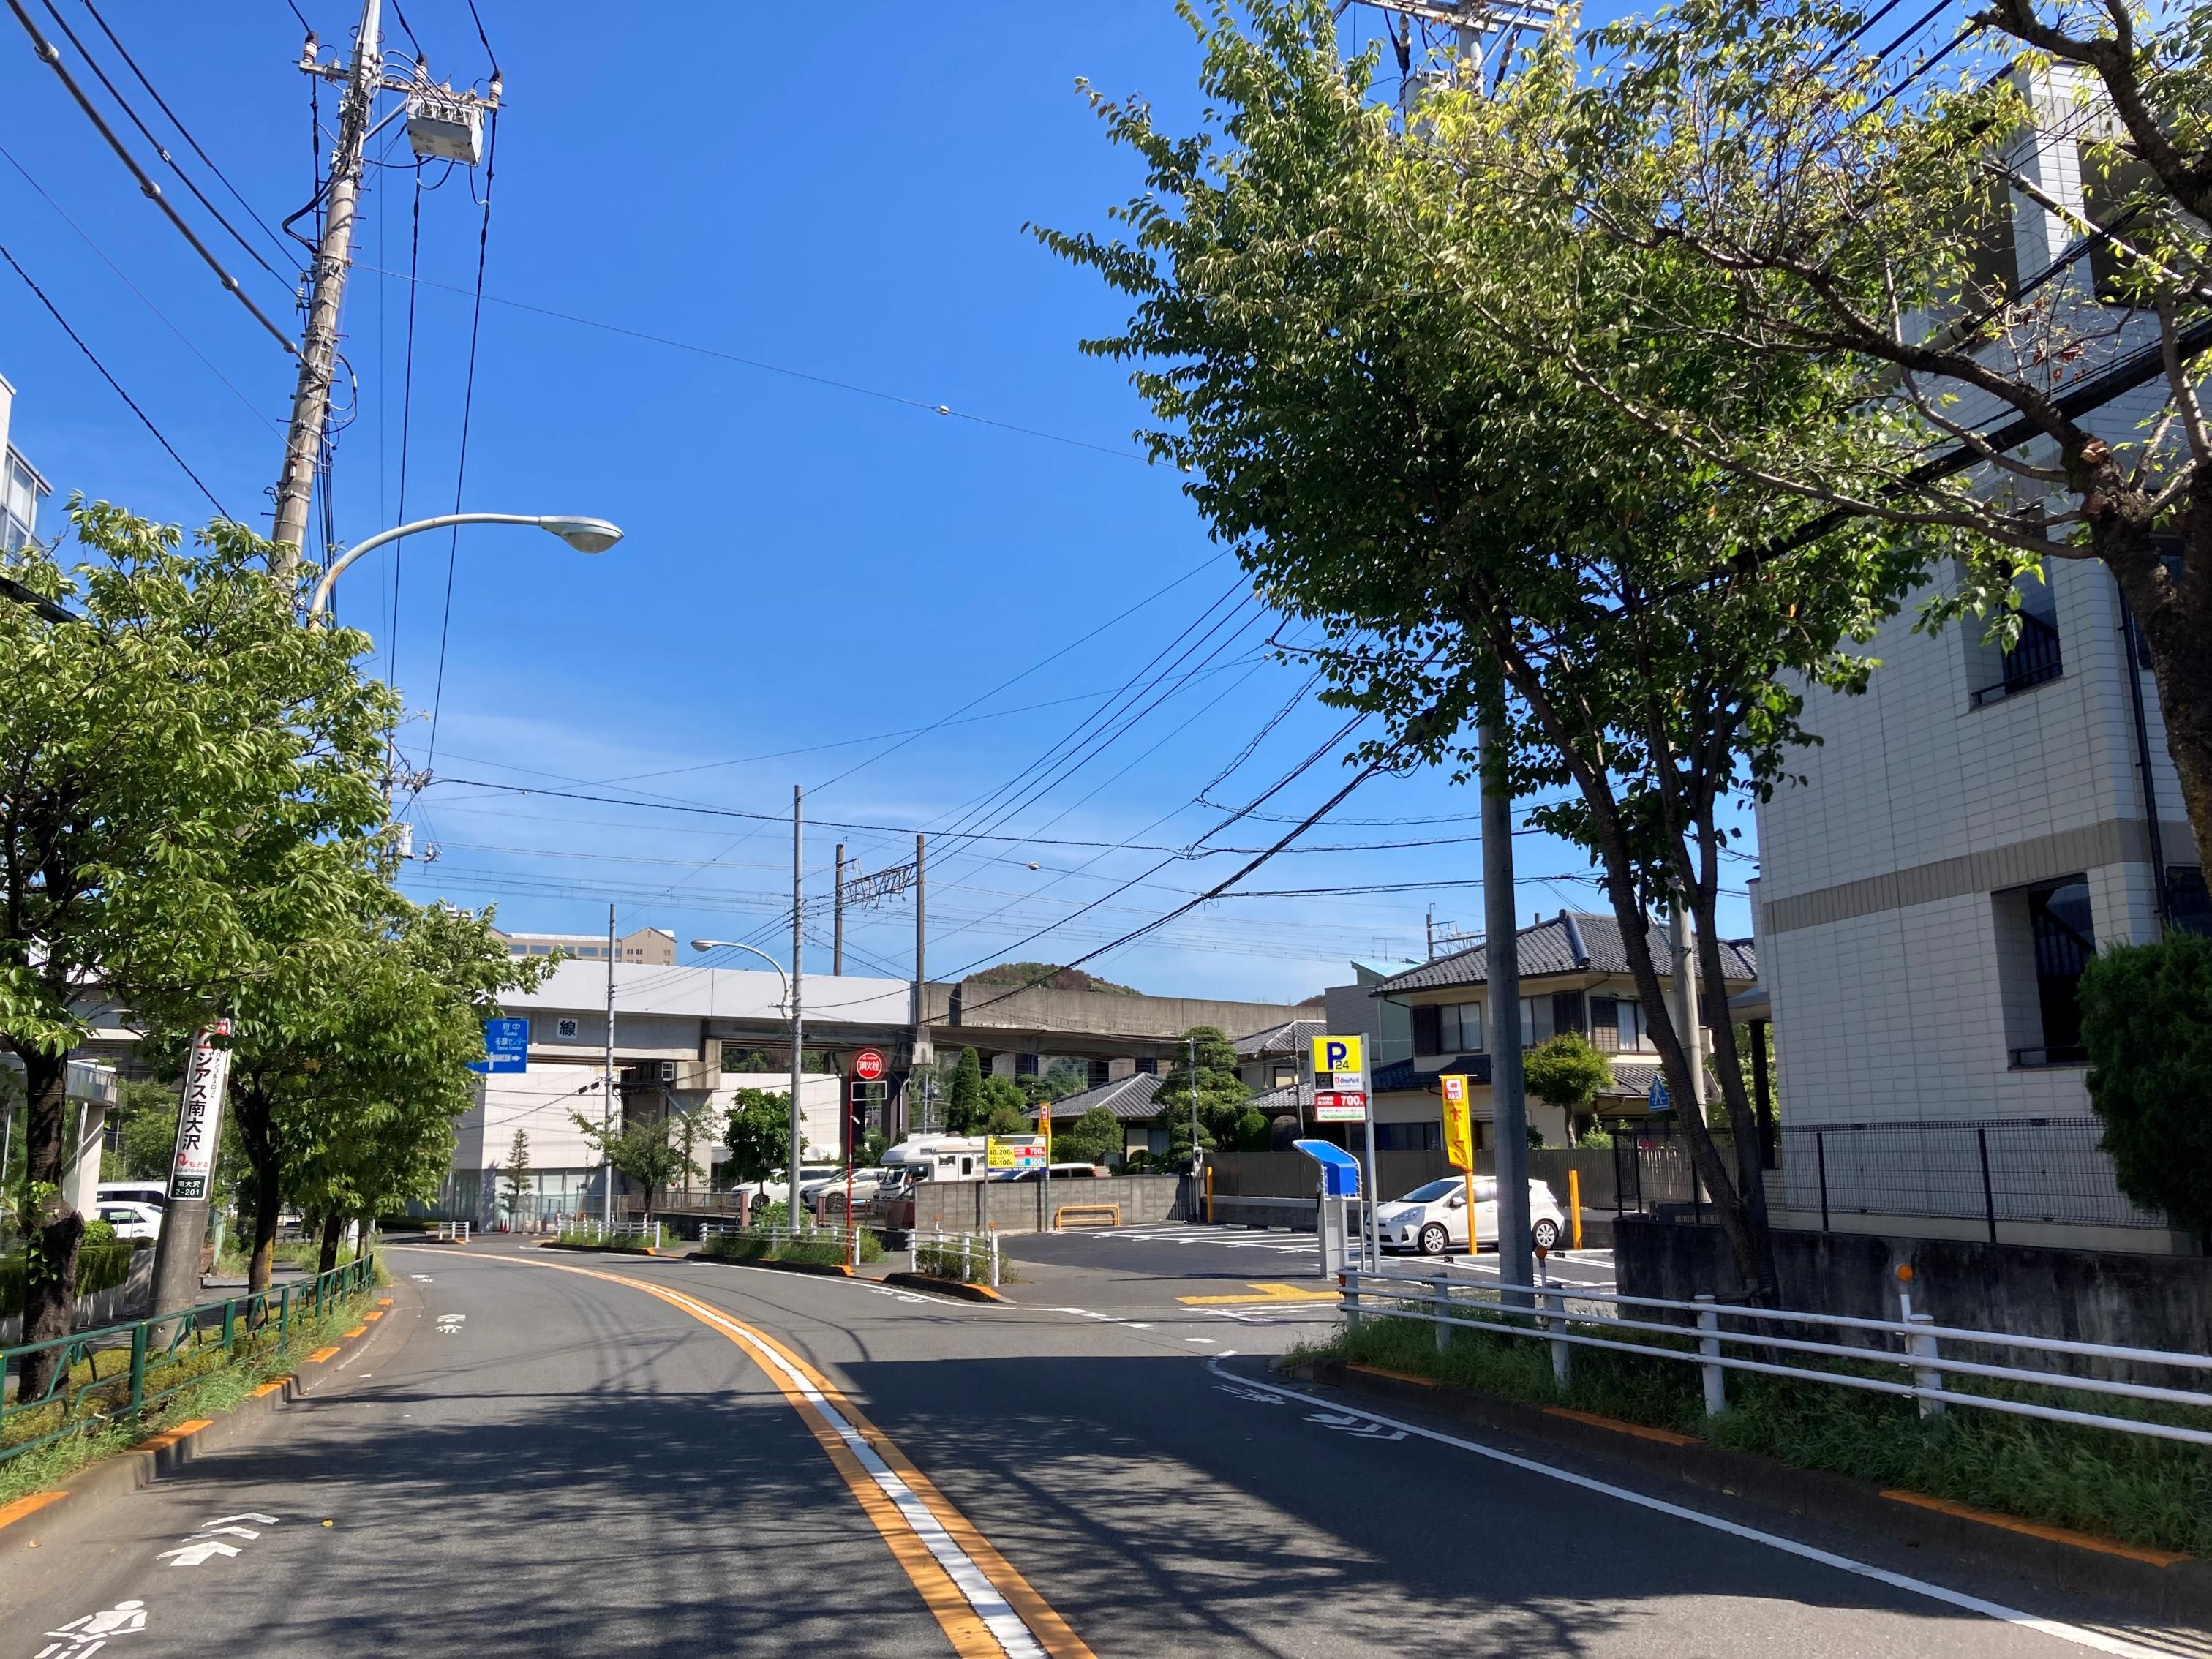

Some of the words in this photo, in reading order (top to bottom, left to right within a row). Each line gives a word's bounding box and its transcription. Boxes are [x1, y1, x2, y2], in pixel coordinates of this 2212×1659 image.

[502, 1023, 520, 1031] 府中
[559, 1020, 576, 1037] 線
[1326, 1042, 1347, 1070] P
[859, 1061, 880, 1072] 消火栓
[1336, 1060, 1350, 1070] 24
[177, 1180, 200, 1188] 南大沢
